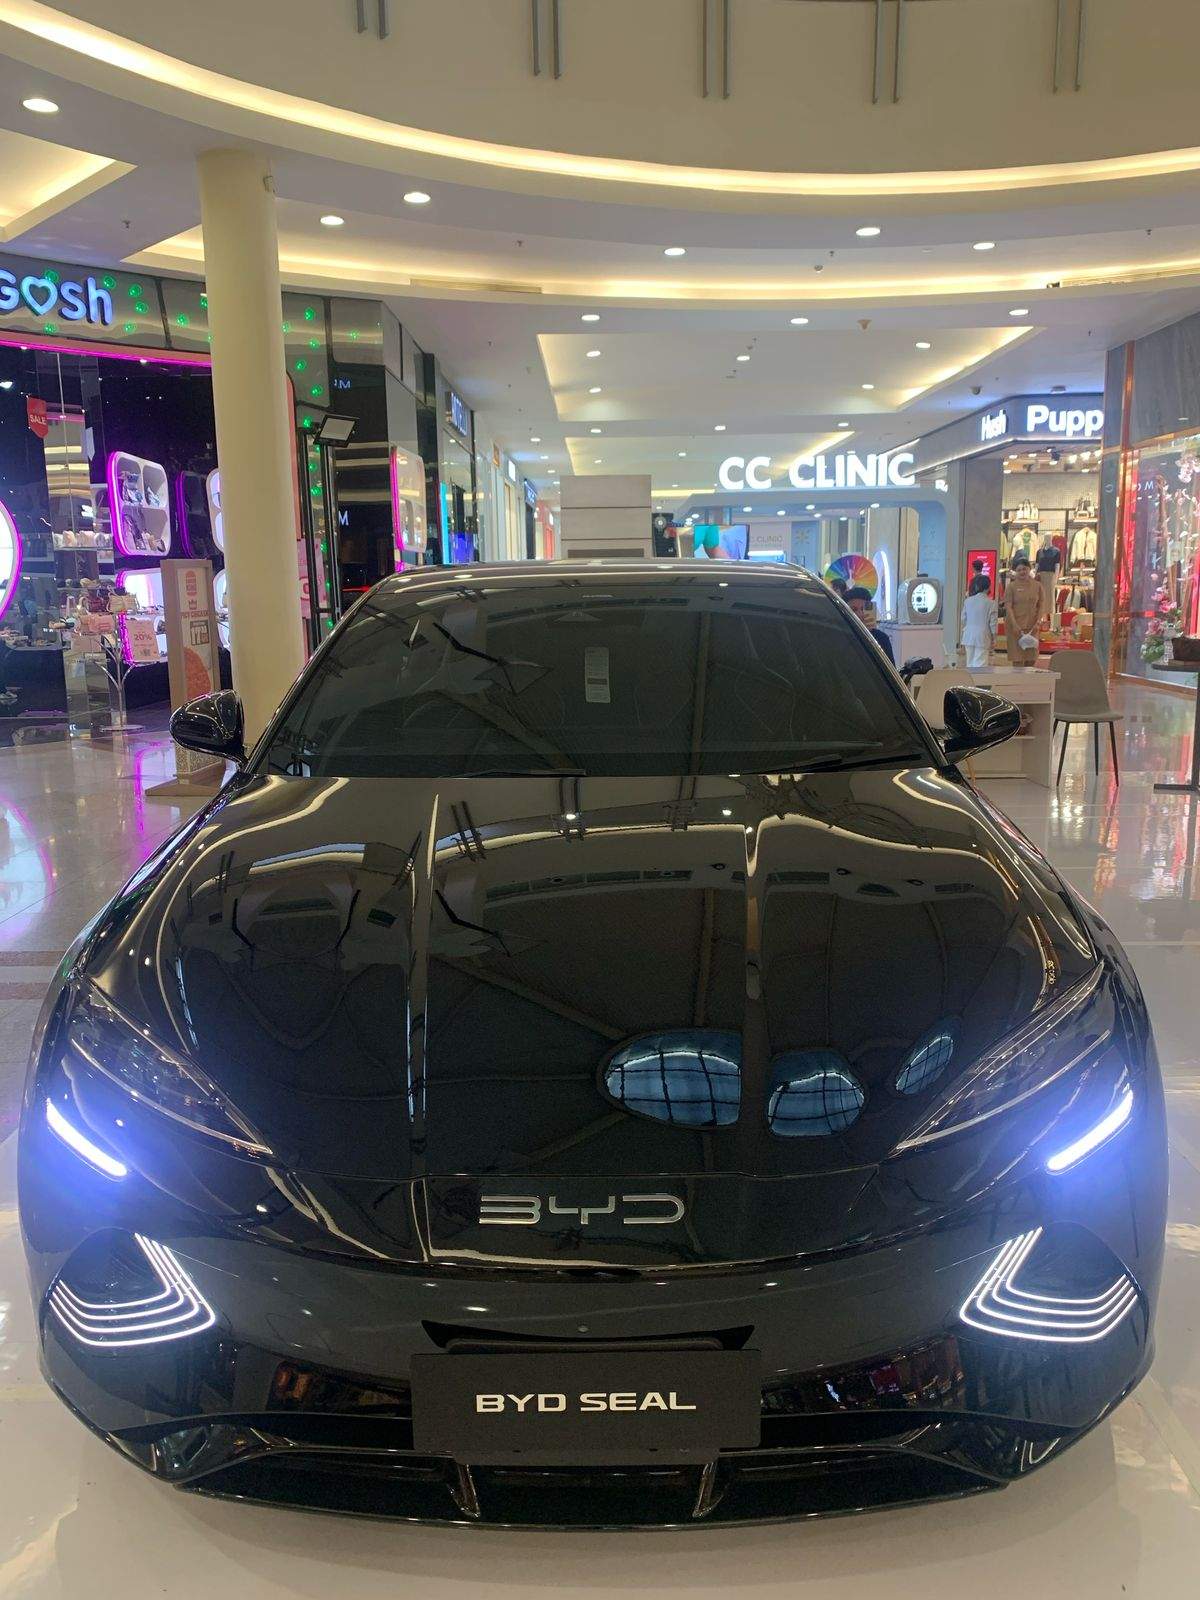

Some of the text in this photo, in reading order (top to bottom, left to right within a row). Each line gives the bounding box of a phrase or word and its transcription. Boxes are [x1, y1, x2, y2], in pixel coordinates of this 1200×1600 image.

[30, 414, 47, 425] SALE
[718, 452, 916, 490] CC CLINIC
[478, 1193, 685, 1225] BYD
[475, 1391, 697, 1413] BYD SEAL
